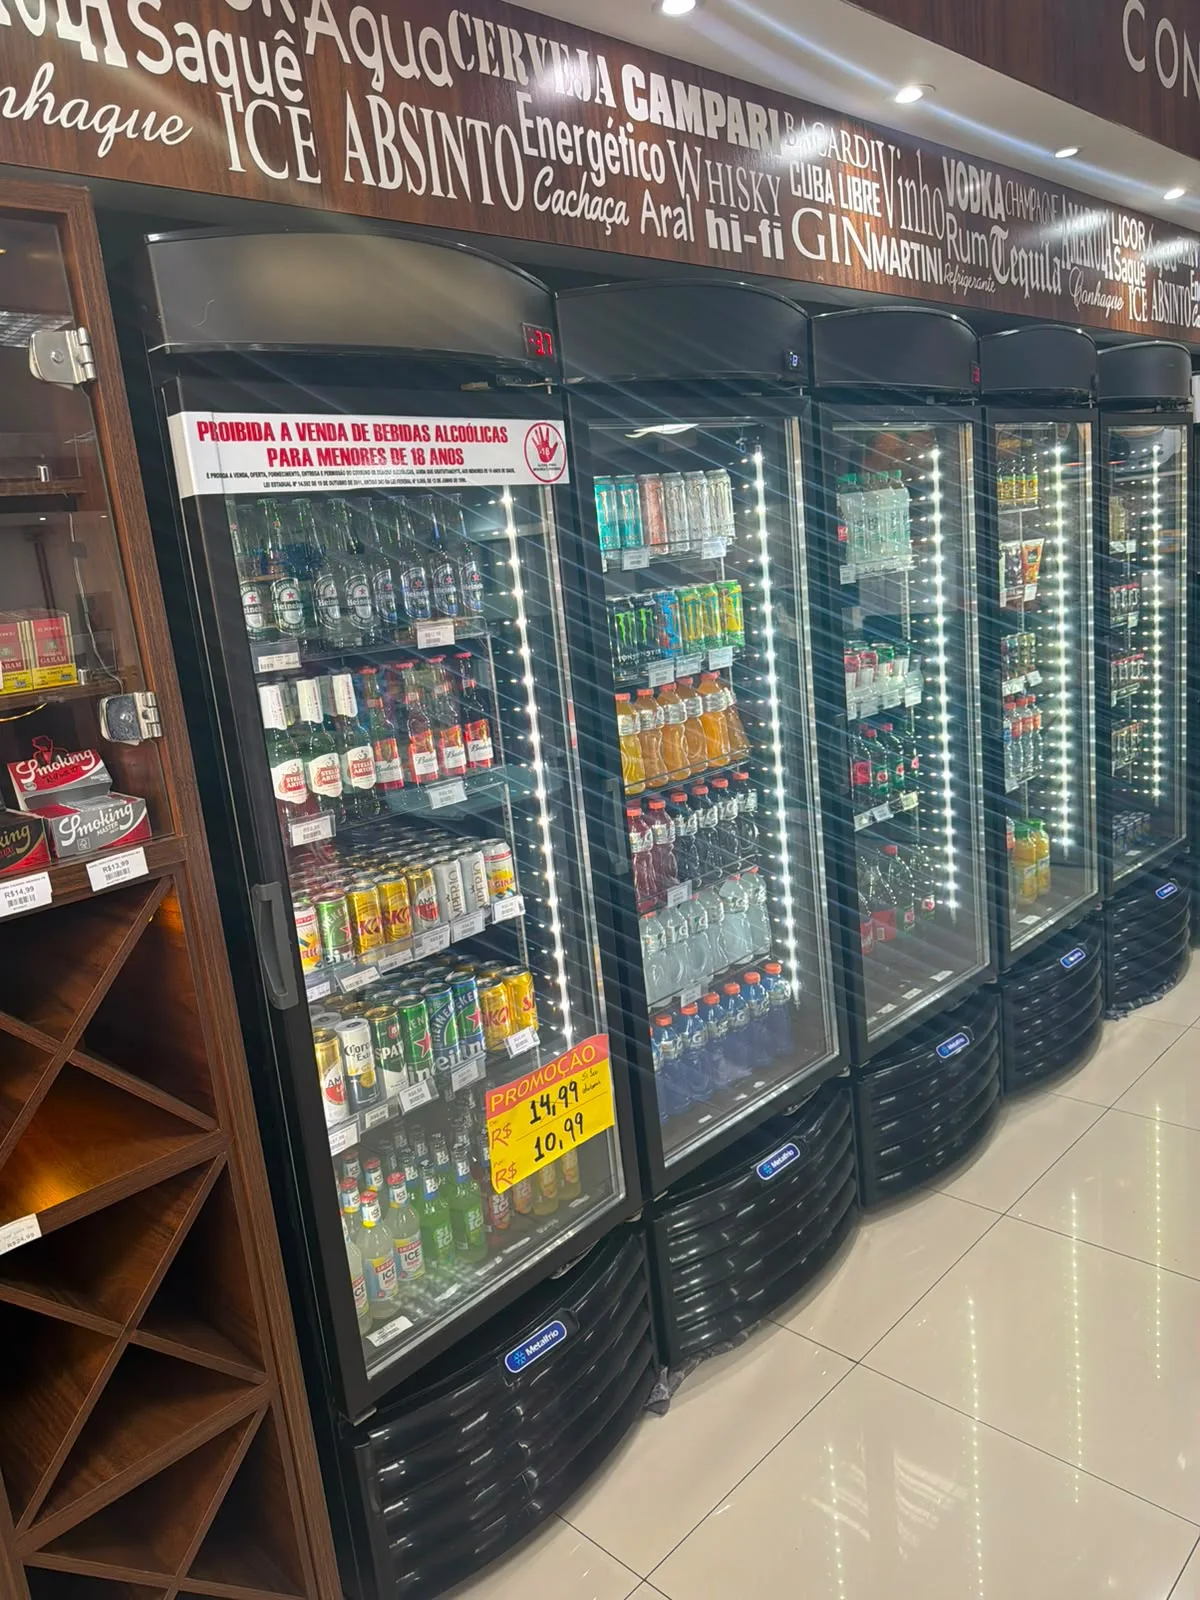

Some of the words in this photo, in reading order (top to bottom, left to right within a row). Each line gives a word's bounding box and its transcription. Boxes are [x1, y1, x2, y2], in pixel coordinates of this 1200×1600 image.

[127, 0, 303, 113] Saquê
[448, 9, 617, 109] CERVEJA
[217, 92, 321, 183] ICE
[516, 91, 666, 187] Energético
[621, 63, 782, 158] CAMPARI
[344, 90, 525, 212] ABSINTO
[667, 139, 781, 217] WHISKY
[533, 166, 630, 236] Cachaça
[640, 189, 695, 242] Aral
[790, 160, 835, 206] CUBA
[839, 173, 882, 218] LIBRE
[874, 140, 945, 240] Vinho
[943, 156, 1006, 223] VODKA
[705, 209, 784, 260] hi-fi
[791, 207, 872, 271] GIN
[870, 231, 943, 285] MARTINI
[945, 212, 989, 268] Rum
[1111, 212, 1146, 252] LICOR
[990, 225, 1062, 299] Tequila
[1114, 246, 1146, 287] Saquê
[1069, 266, 1124, 318] Conhaque
[1128, 286, 1148, 322] ICE
[1151, 278, 1191, 328] ABSINTO
[196, 421, 275, 442] PROIBIDA
[280, 422, 292, 442] A
[295, 422, 351, 442] VENDA
[351, 423, 369, 442] DE
[372, 423, 431, 443] BEBIDAS
[435, 422, 508, 444] ALCOÓLICAS
[267, 448, 314, 467] PARA
[317, 447, 387, 467] MENORES
[390, 447, 408, 466] DE
[410, 448, 426, 466] 18
[430, 447, 464, 466] ANOS
[1, 661, 22, 670] ARAM
[16, 749, 95, 784] Smoking
[59, 801, 134, 847] Smoking
[491, 1044, 596, 1113] PROMOÇÃO
[491, 1123, 512, 1150] R$
[530, 1081, 579, 1124] 14,99
[494, 1162, 518, 1190] R$
[534, 1112, 583, 1162] 10,99
[525, 1329, 560, 1357] Metalfrio
